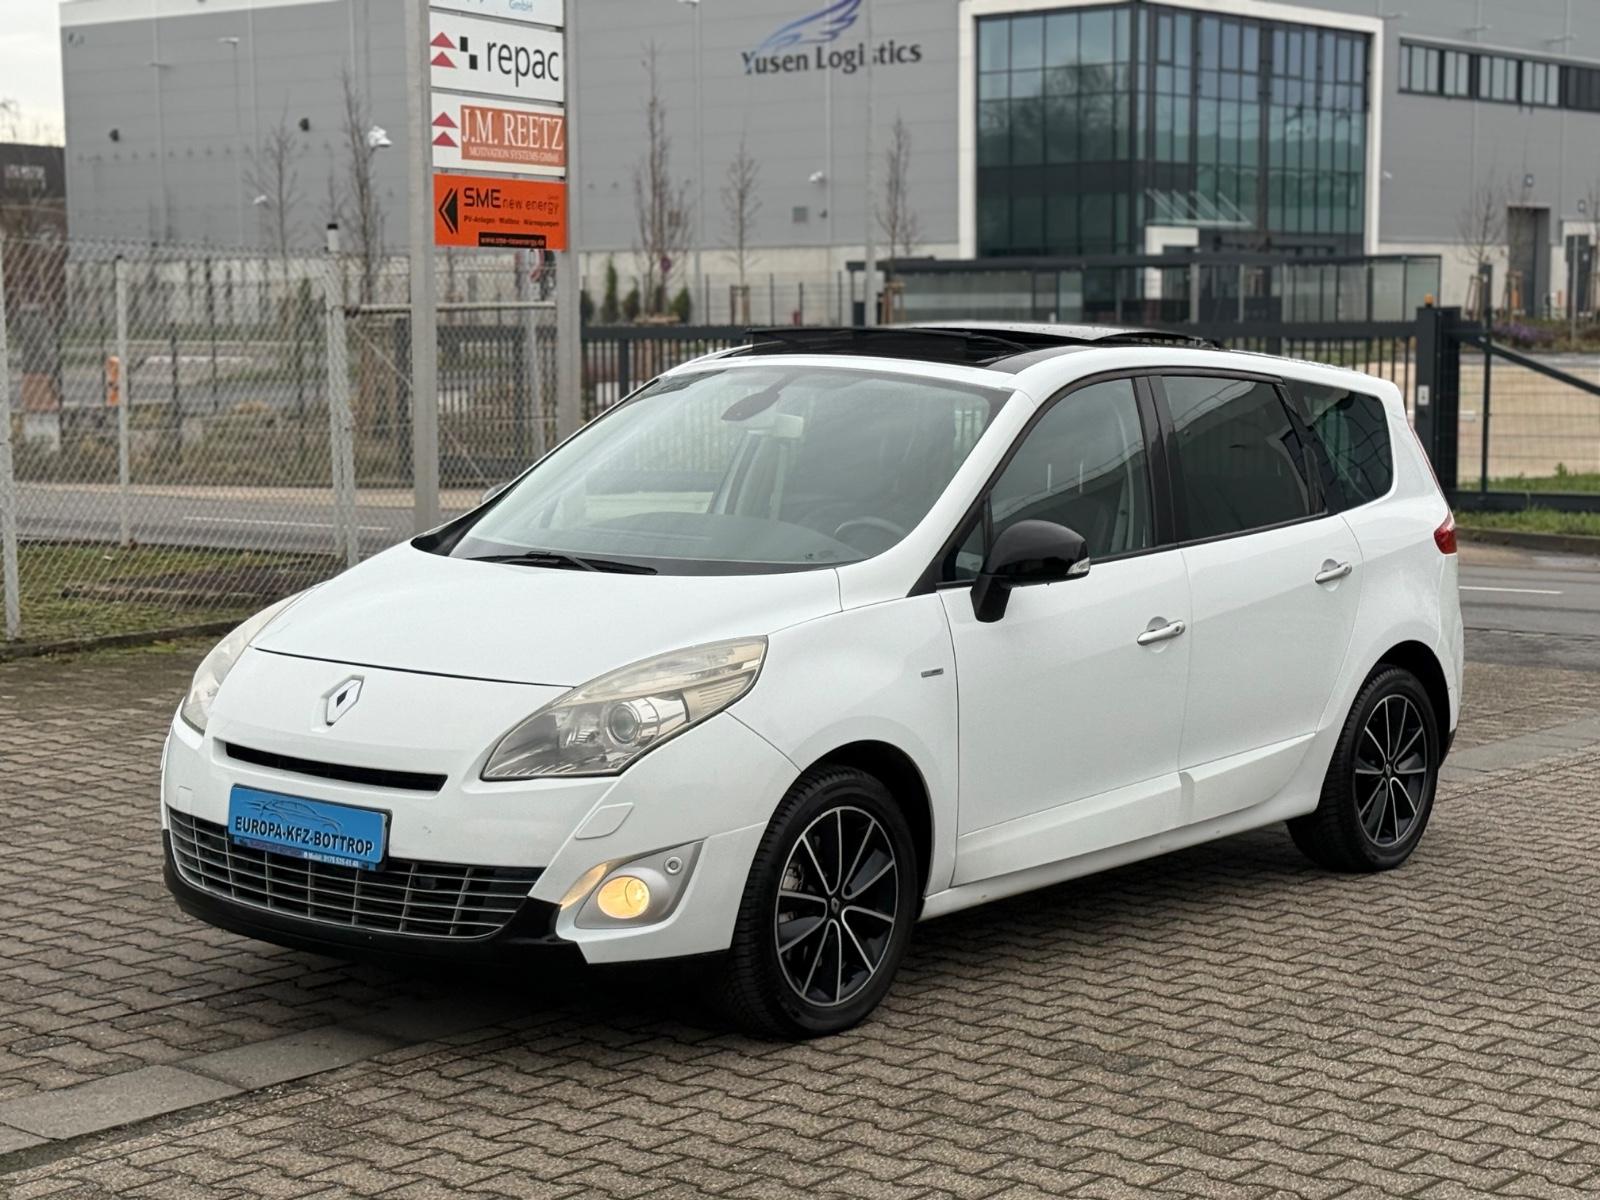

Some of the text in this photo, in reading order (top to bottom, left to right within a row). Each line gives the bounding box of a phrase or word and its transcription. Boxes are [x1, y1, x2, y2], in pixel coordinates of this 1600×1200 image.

[487, 41, 559, 88] repac
[741, 39, 922, 75] Yusen Logitics
[462, 108, 564, 150] J.M. REETZ
[463, 187, 559, 215] SME new energy
[235, 816, 374, 857] EUROPA-KFZ-BOTTROP
